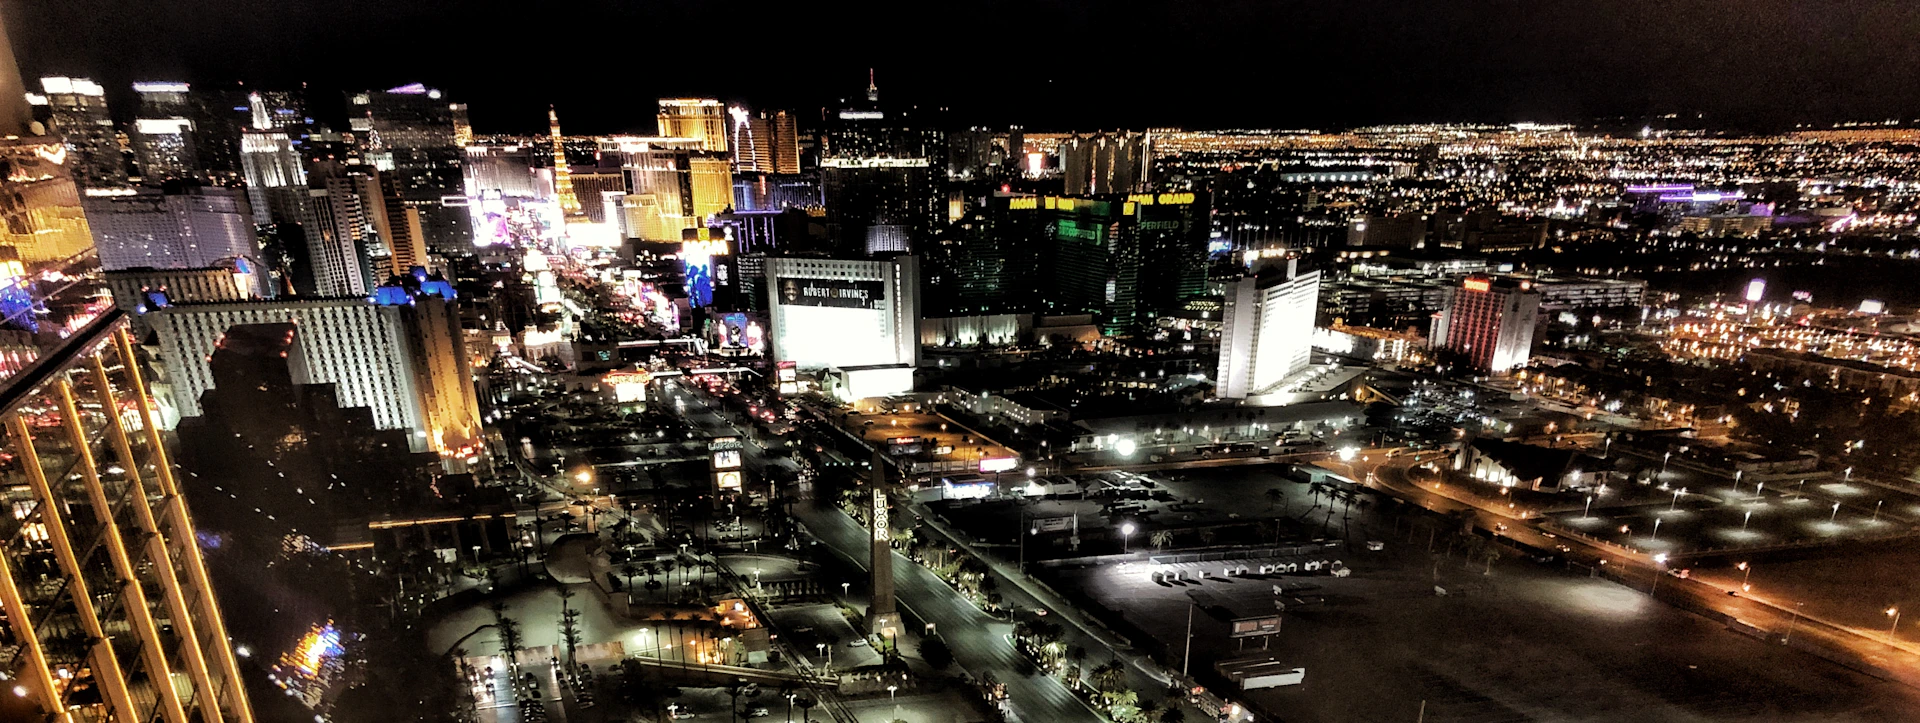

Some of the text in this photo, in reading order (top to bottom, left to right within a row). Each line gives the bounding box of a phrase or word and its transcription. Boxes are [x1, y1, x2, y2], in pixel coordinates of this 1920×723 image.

[1009, 197, 1037, 210] MGM
[1158, 193, 1195, 205] GRAND
[803, 286, 869, 300] ROBERT IRVINE'S
[708, 440, 744, 451] LUXOR
[873, 488, 889, 541] LUXOR
